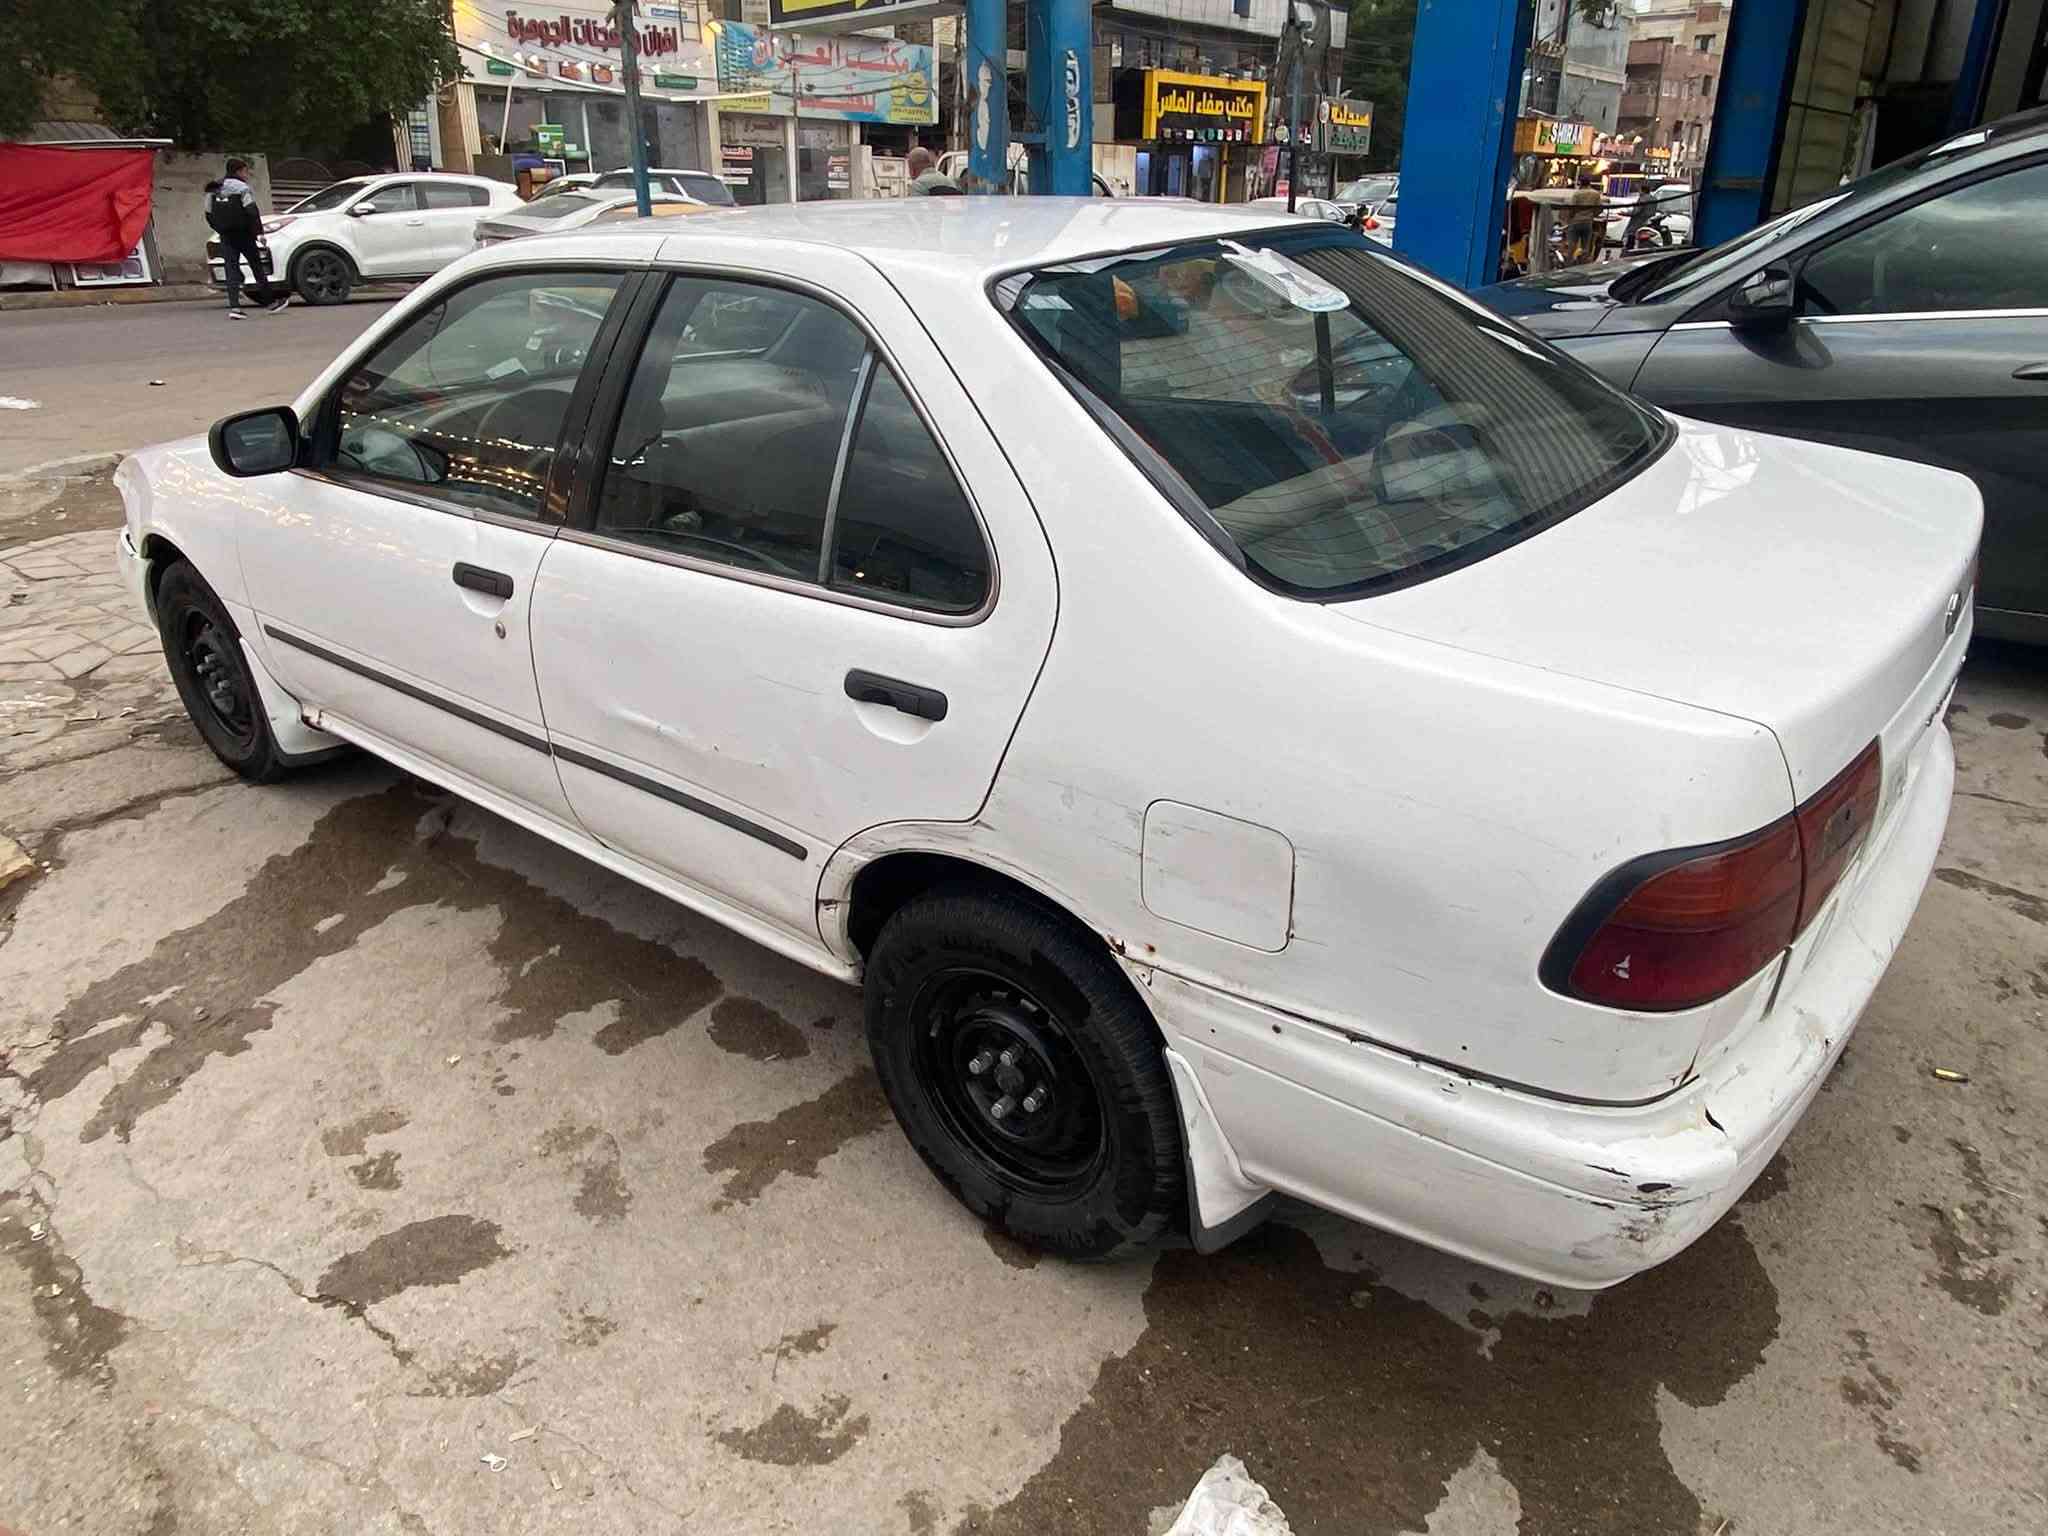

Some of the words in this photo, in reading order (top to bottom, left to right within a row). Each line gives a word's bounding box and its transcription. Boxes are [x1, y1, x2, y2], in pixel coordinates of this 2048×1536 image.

[506, 10, 572, 48] الجوهرة
[1157, 89, 1195, 118] الماس
[1226, 95, 1253, 122] مكتب
